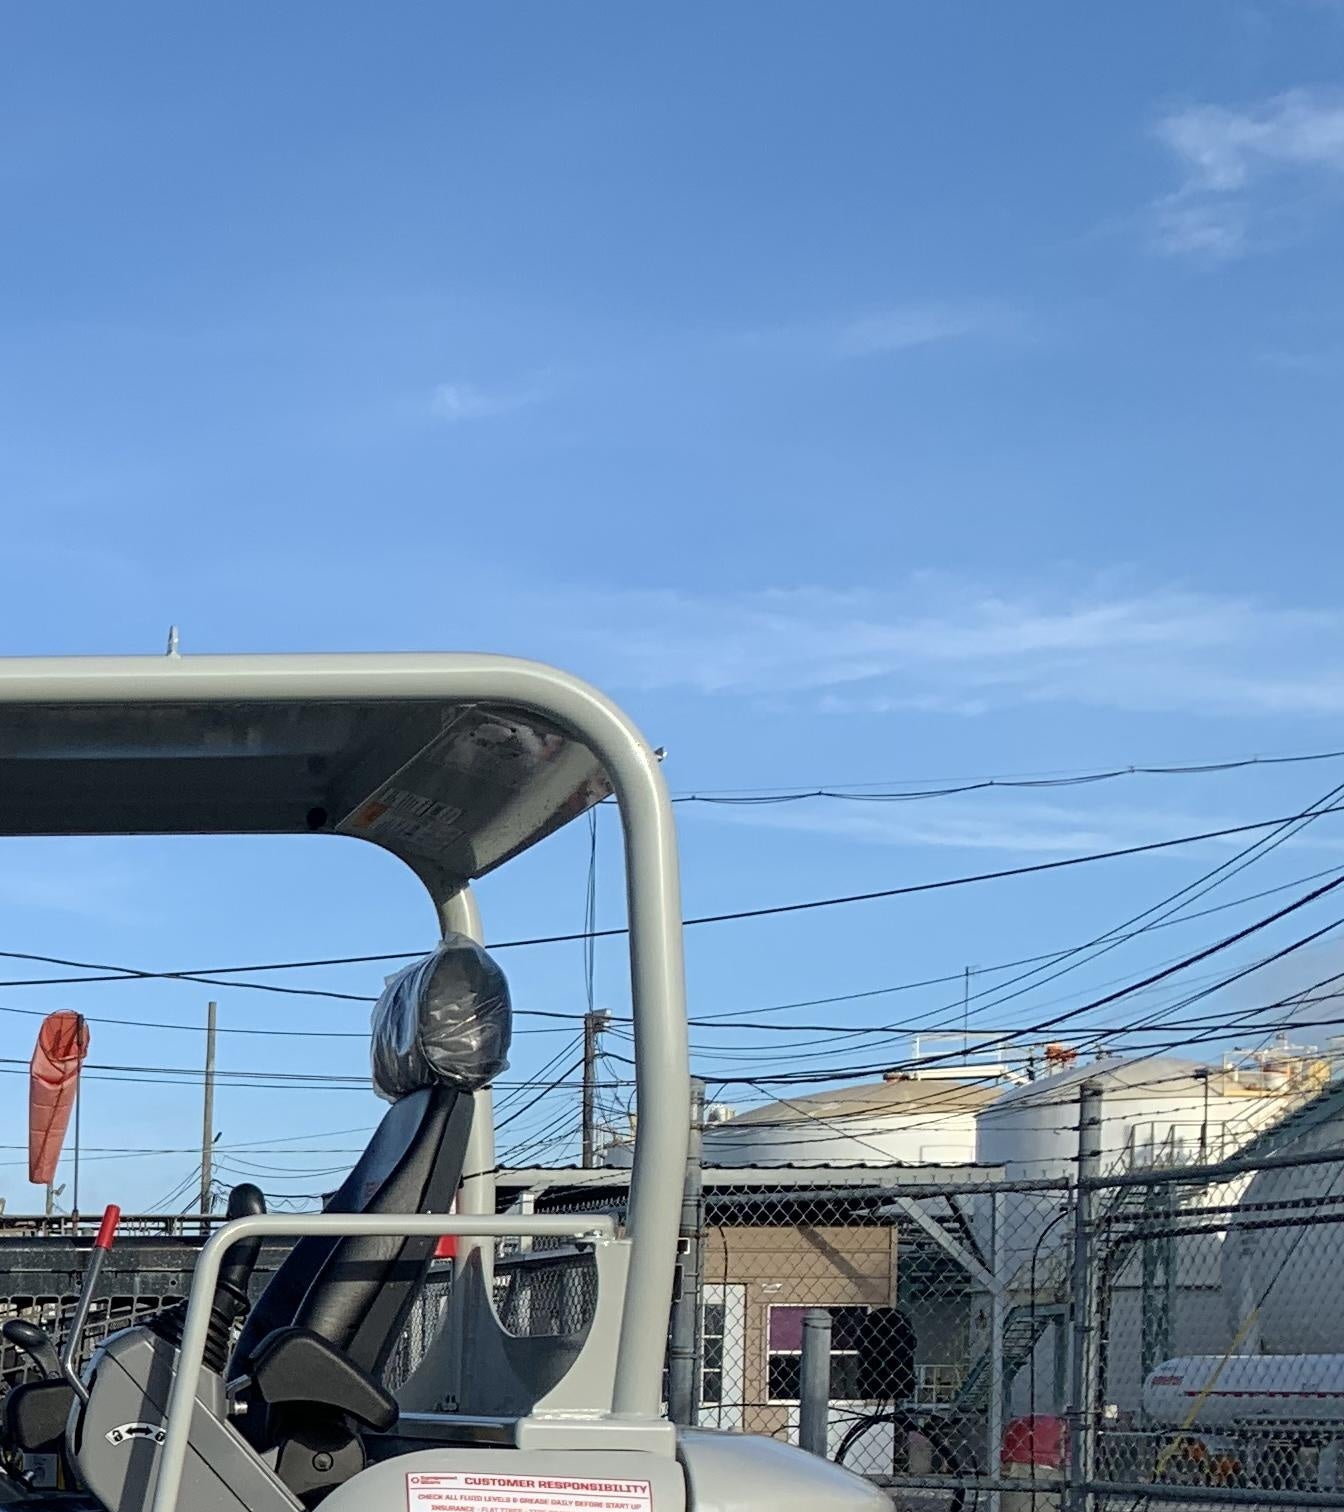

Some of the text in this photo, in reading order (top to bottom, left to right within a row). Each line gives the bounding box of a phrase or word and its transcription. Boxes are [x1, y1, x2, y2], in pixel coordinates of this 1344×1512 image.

[464, 1477, 535, 1488] CUSTOMER
[538, 1480, 647, 1494] RESPONSIBILITY
[432, 1504, 475, 1512] INSURANCE
[575, 1500, 603, 1508] BEFORE
